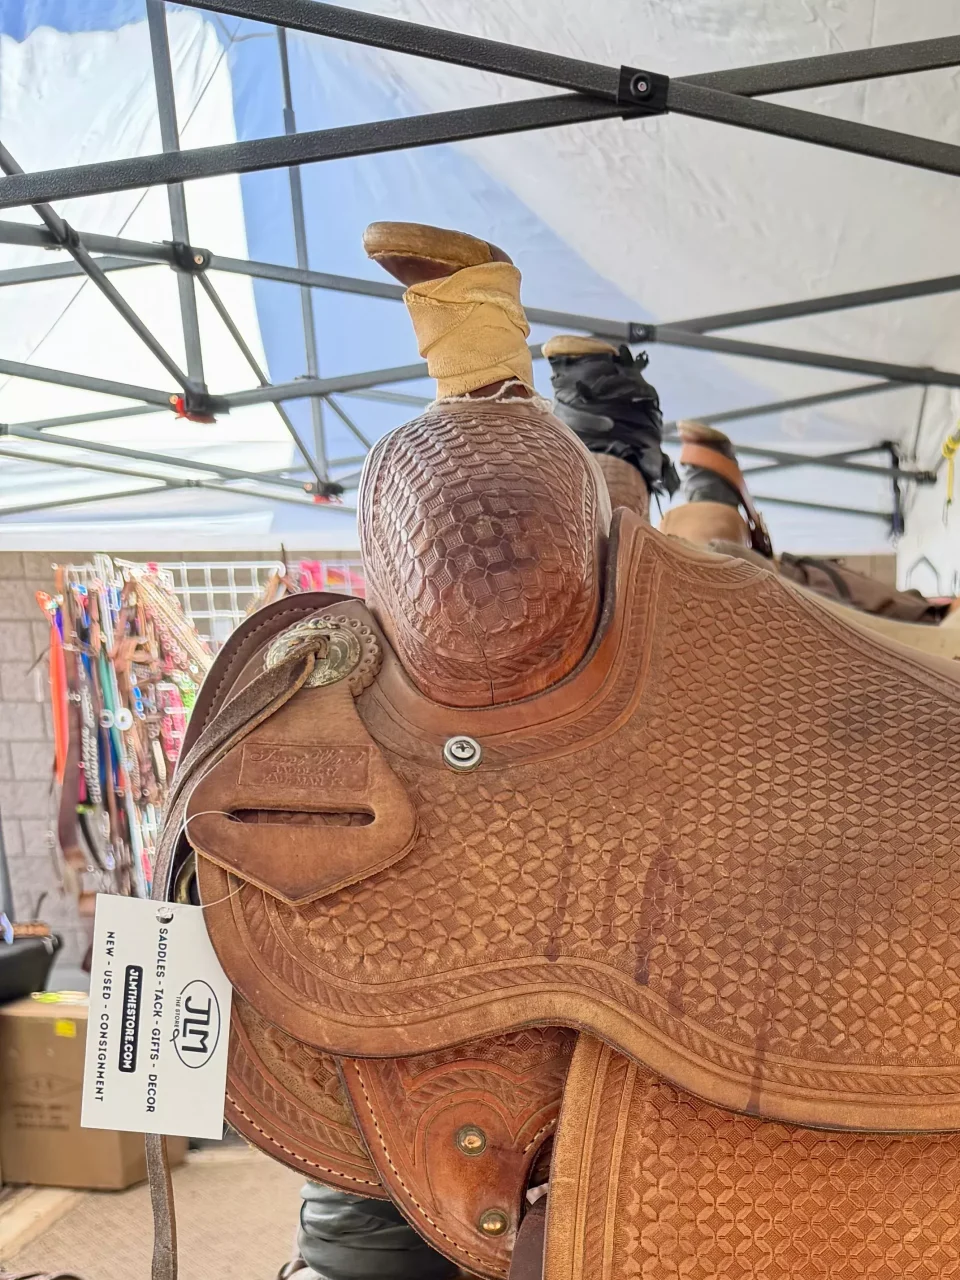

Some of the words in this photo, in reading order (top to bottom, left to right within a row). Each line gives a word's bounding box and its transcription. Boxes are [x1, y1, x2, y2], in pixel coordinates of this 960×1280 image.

[104, 931, 115, 957] NEW
[155, 927, 168, 978] SADDLES
[102, 970, 113, 1000] USED
[174, 995, 182, 1008] THE
[122, 968, 139, 1070] JLMTHESTORE.COM
[152, 988, 164, 1017] TACK
[173, 1008, 181, 1028] STORE
[180, 995, 211, 1055] JLM
[94, 1013, 110, 1102] CONSIGNMENT
[149, 1027, 161, 1061] GIFTS
[145, 1073, 157, 1113] DECOR
